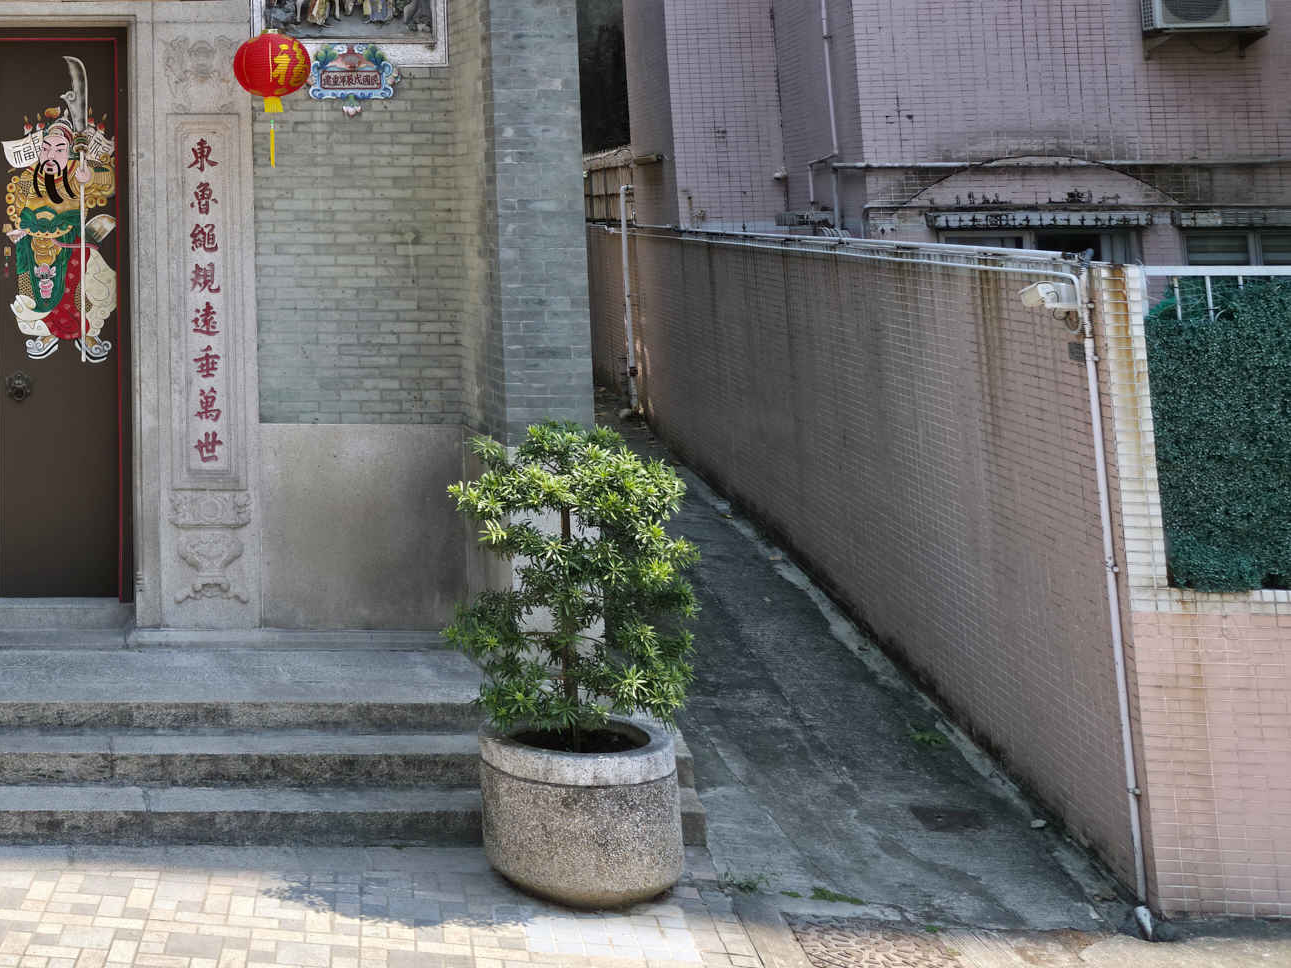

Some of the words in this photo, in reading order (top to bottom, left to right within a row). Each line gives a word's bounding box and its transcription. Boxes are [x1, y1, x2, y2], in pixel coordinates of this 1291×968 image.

[272, 41, 308, 87] 福
[187, 138, 224, 464] 東魯繩規遠垂萬世
